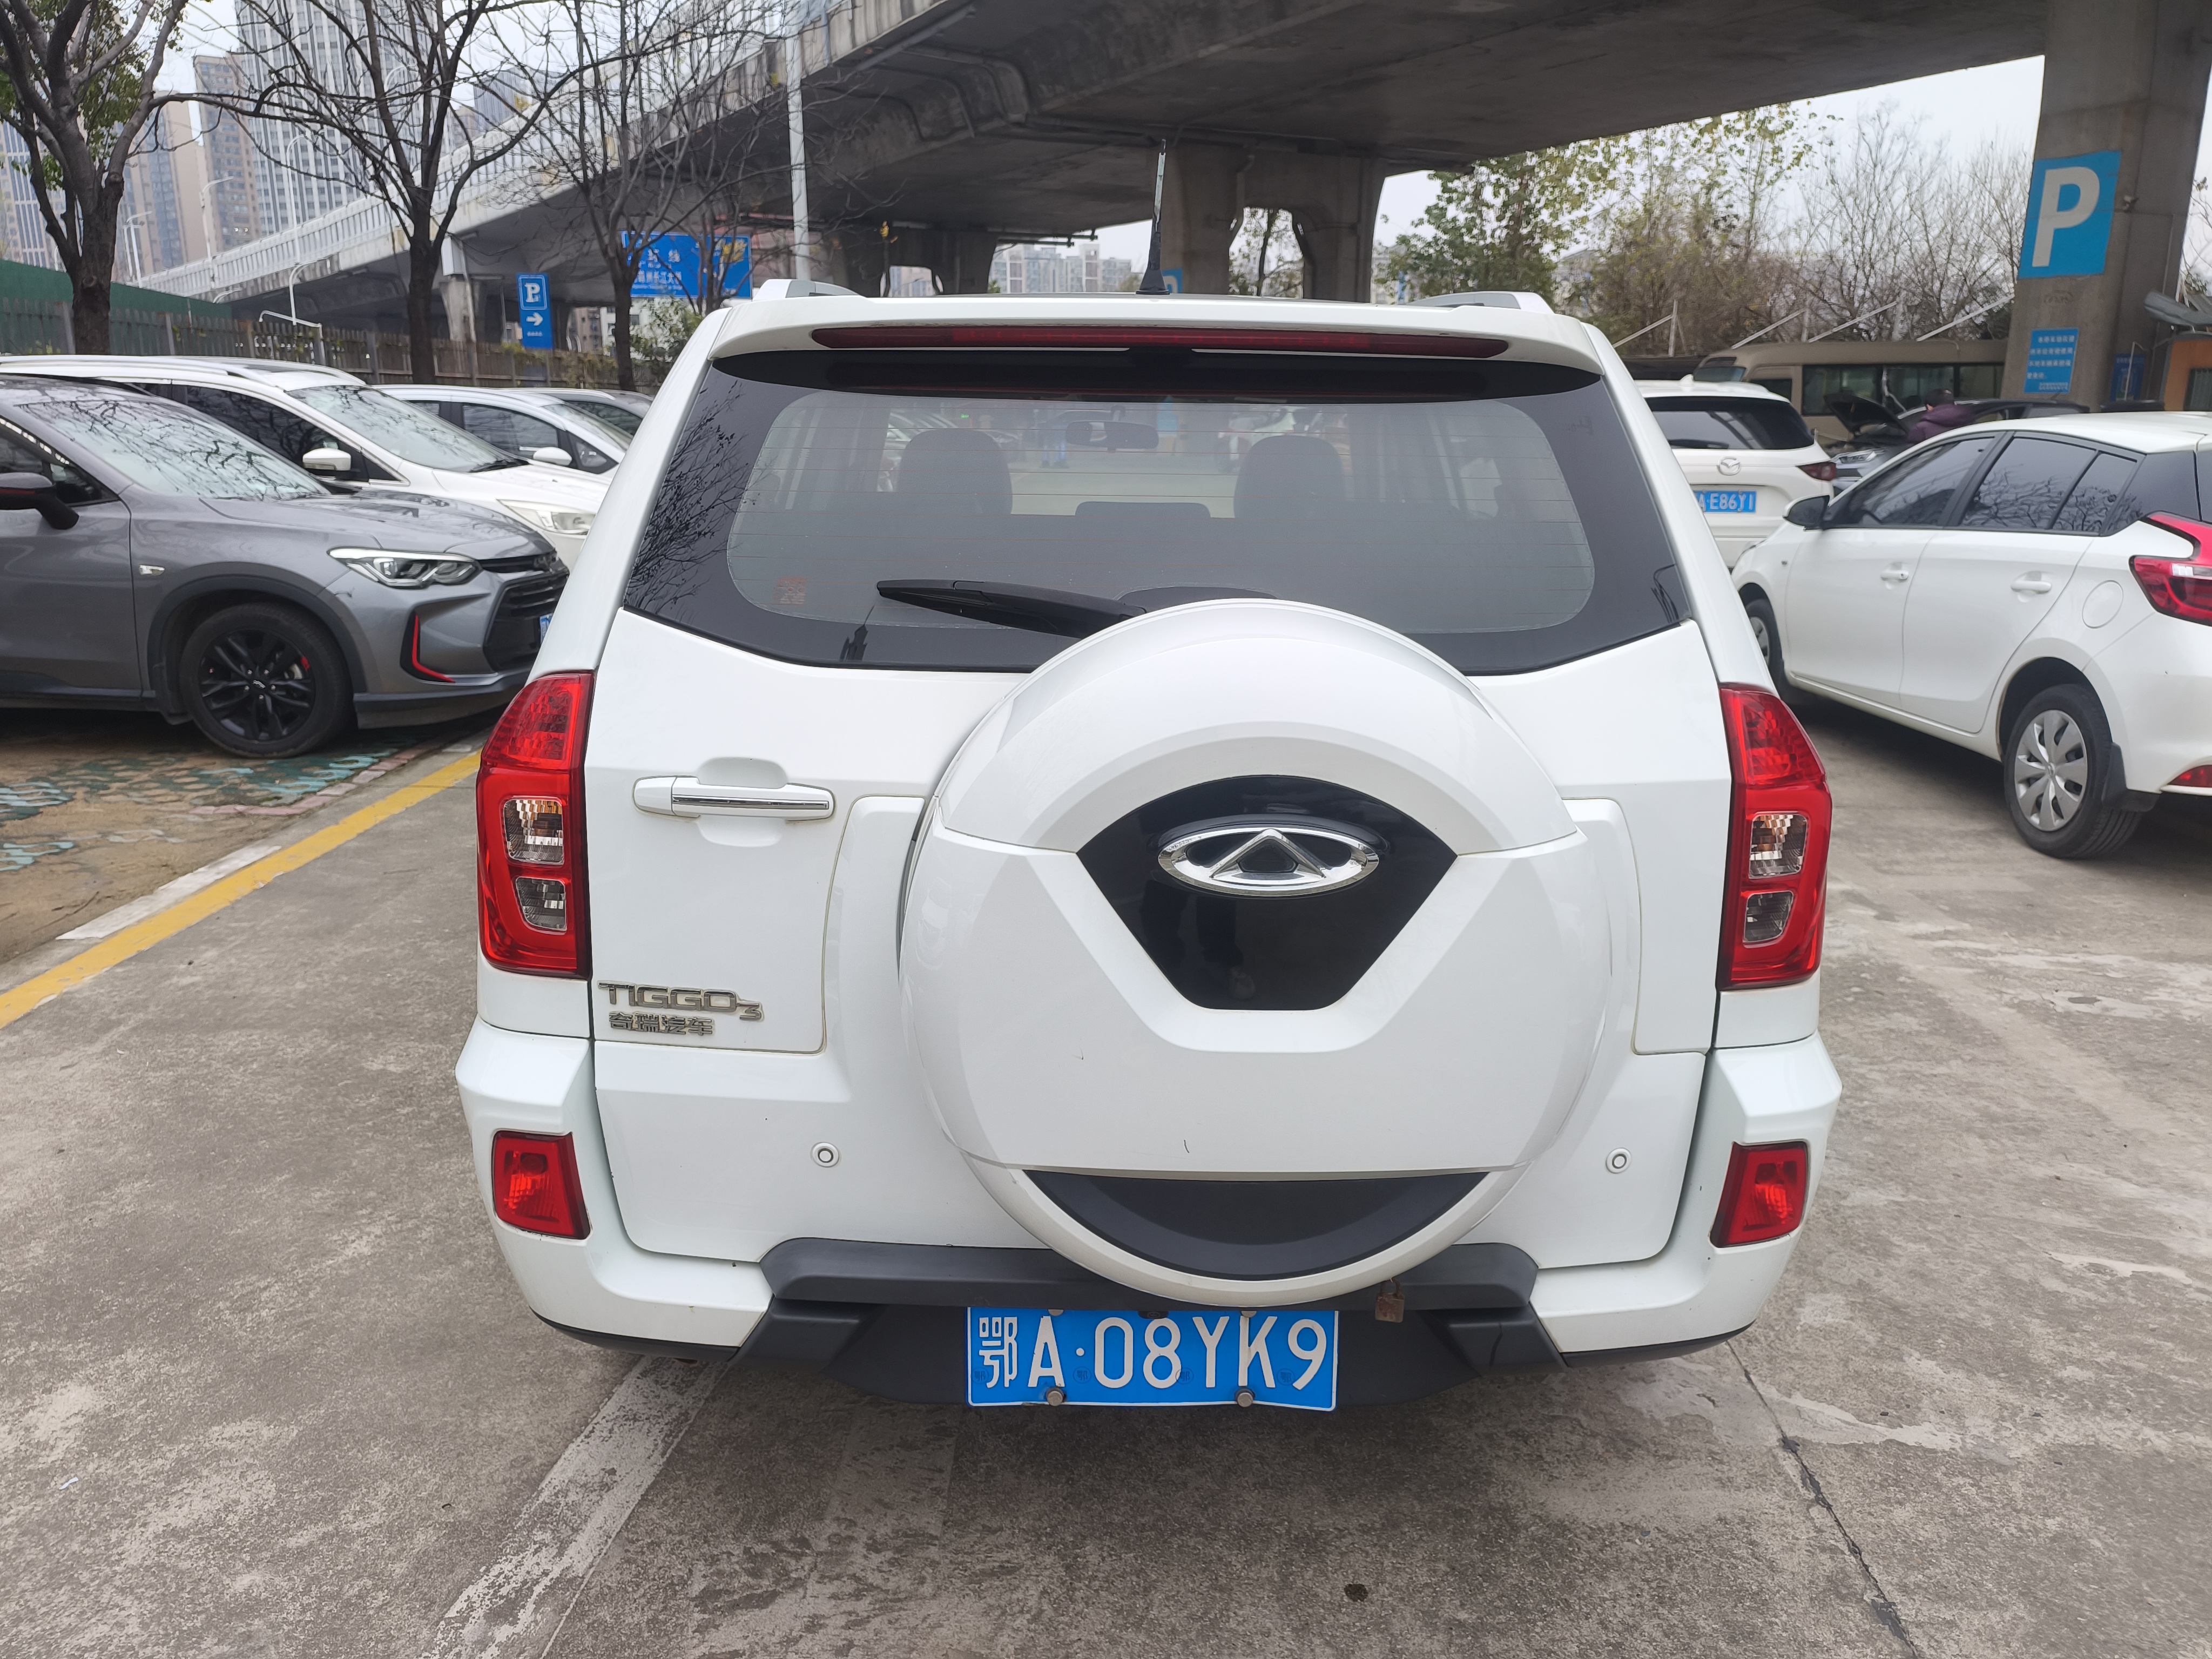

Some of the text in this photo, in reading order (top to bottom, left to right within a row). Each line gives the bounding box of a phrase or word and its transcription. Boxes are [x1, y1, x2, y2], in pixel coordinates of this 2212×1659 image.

[2032, 167, 2100, 267] P
[524, 282, 540, 302] P
[1696, 493, 1754, 511] A·E86Y1
[609, 1012, 713, 1035] 奇瑞汽车
